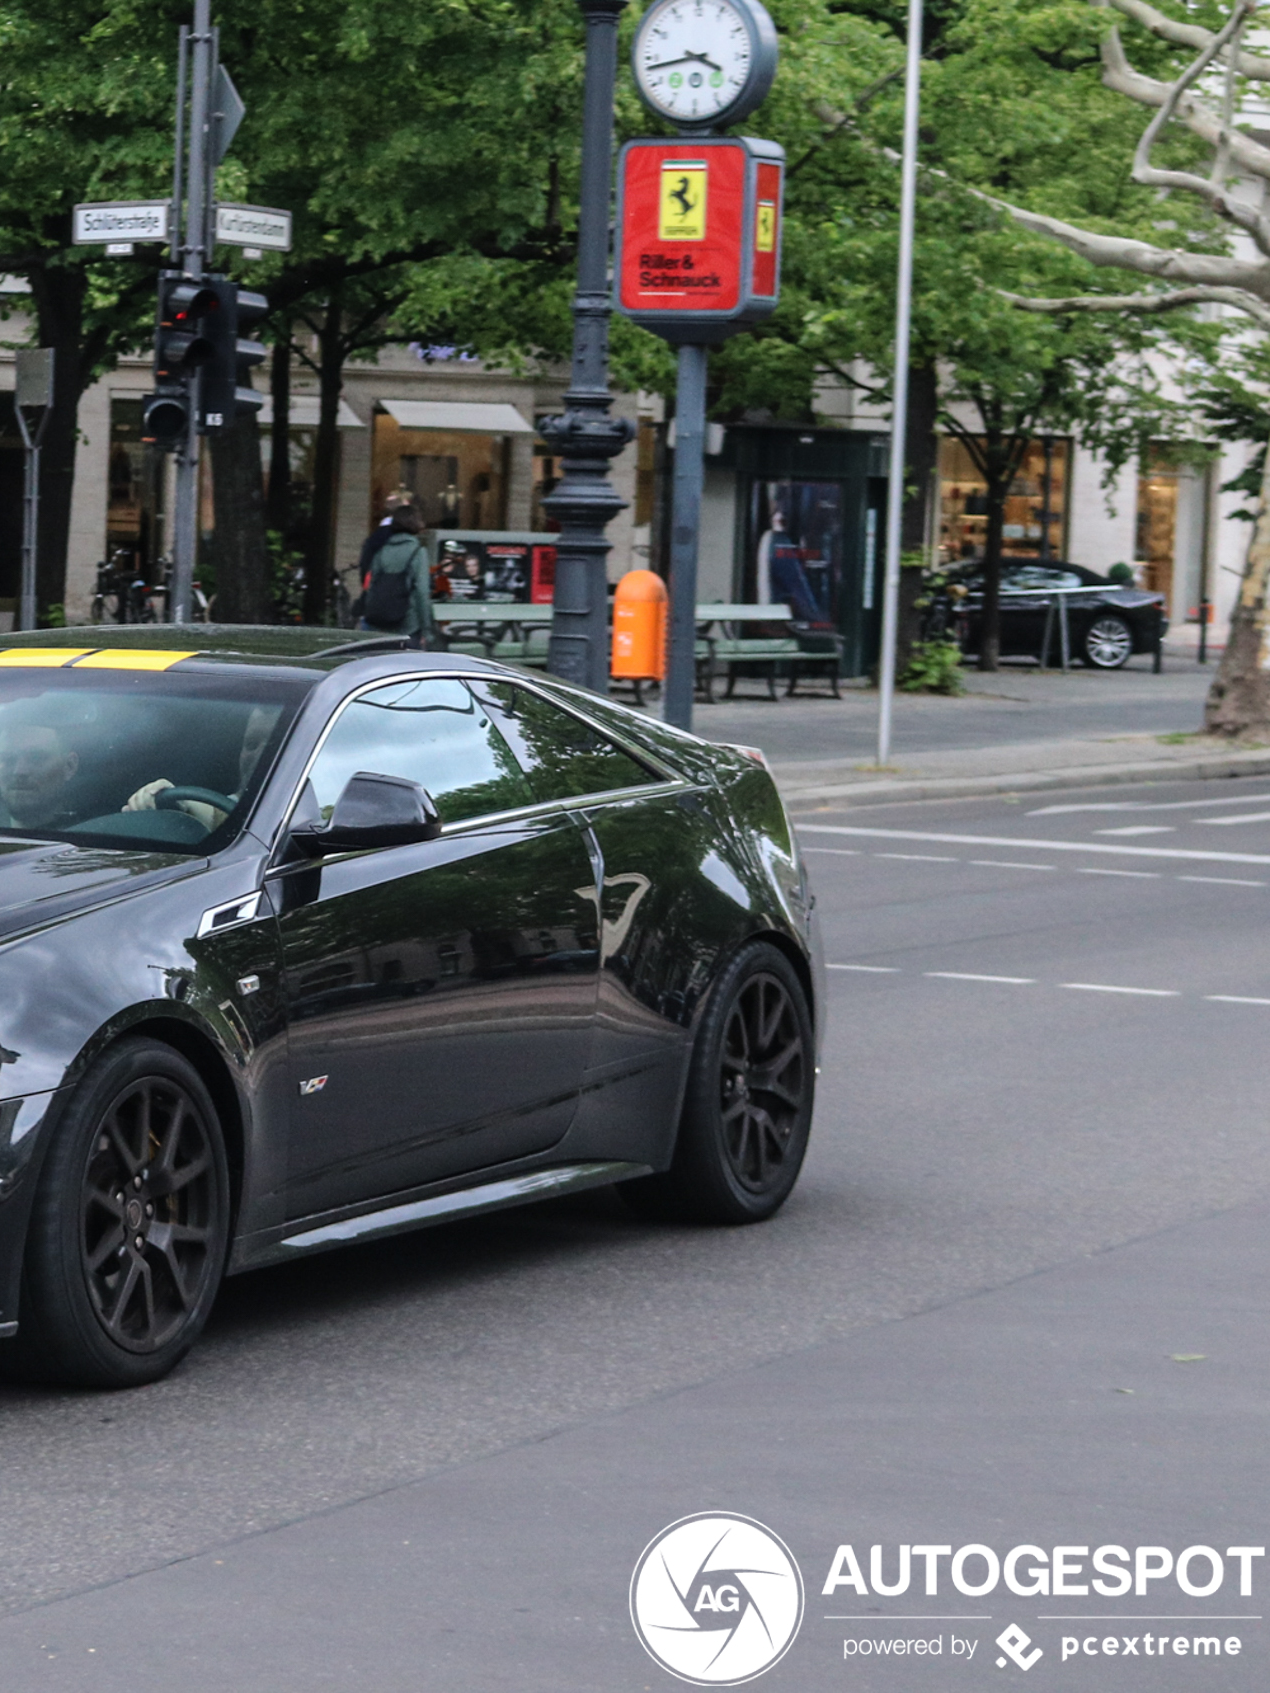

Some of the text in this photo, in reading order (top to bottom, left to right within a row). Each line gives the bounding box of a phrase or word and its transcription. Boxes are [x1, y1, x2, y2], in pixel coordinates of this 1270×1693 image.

[639, 253, 695, 270] Riller &
[639, 271, 722, 288] Schnauck
